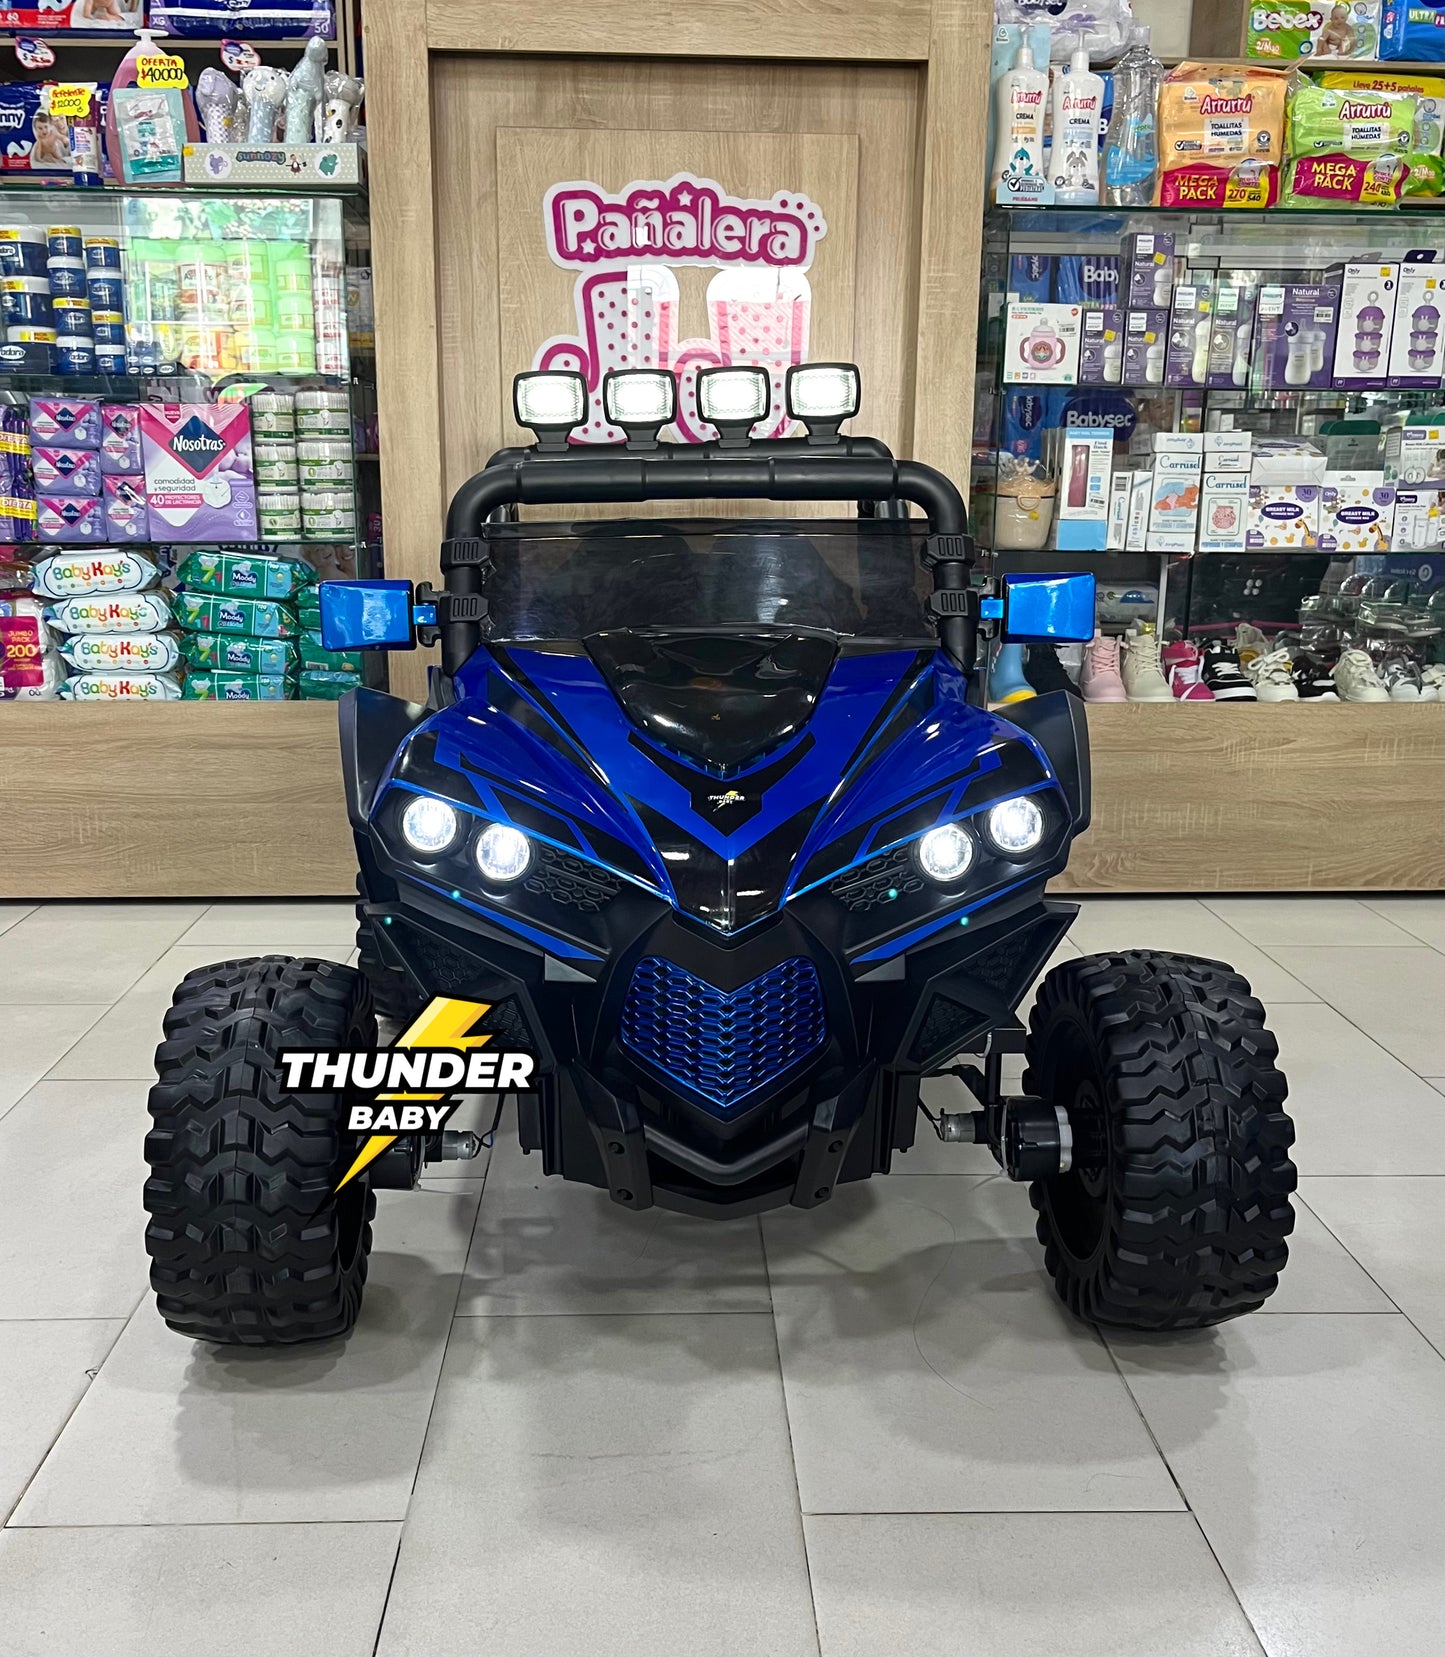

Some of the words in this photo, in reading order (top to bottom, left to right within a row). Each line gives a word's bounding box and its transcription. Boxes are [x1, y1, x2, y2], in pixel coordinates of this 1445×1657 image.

[1252, 9, 1323, 31] Bebex
[314, 23, 329, 34] 50
[141, 57, 178, 67] OFERTA
[1373, 80, 1397, 92] 25+5
[1200, 93, 1253, 115] Arrurrú
[1352, 126, 1382, 134] TOALLITAS
[1311, 162, 1356, 176] MEGA
[1175, 175, 1219, 186] MEGA
[1314, 174, 1354, 190] PACK
[1179, 187, 1217, 199] PACK
[1228, 189, 1246, 199] 270
[561, 196, 801, 259] Pañalera
[1292, 288, 1320, 296] Natural
[1066, 410, 1133, 428] Babysec
[172, 434, 224, 452] Nosotras
[158, 485, 196, 493] seguridad
[150, 494, 165, 505] 40
[52, 564, 91, 581] Baby
[91, 561, 132, 578] Kay's
[232, 572, 257, 585] Moody
[69, 604, 108, 622] Baby
[108, 604, 149, 620] Kay's
[219, 611, 244, 623] Moody
[6, 643, 37, 658] 200
[81, 641, 118, 659] Baby
[119, 641, 159, 658] Kay's
[227, 653, 251, 663] Moody
[80, 680, 118, 698] Baby
[119, 680, 158, 698] Kay's
[225, 691, 250, 700] Moody
